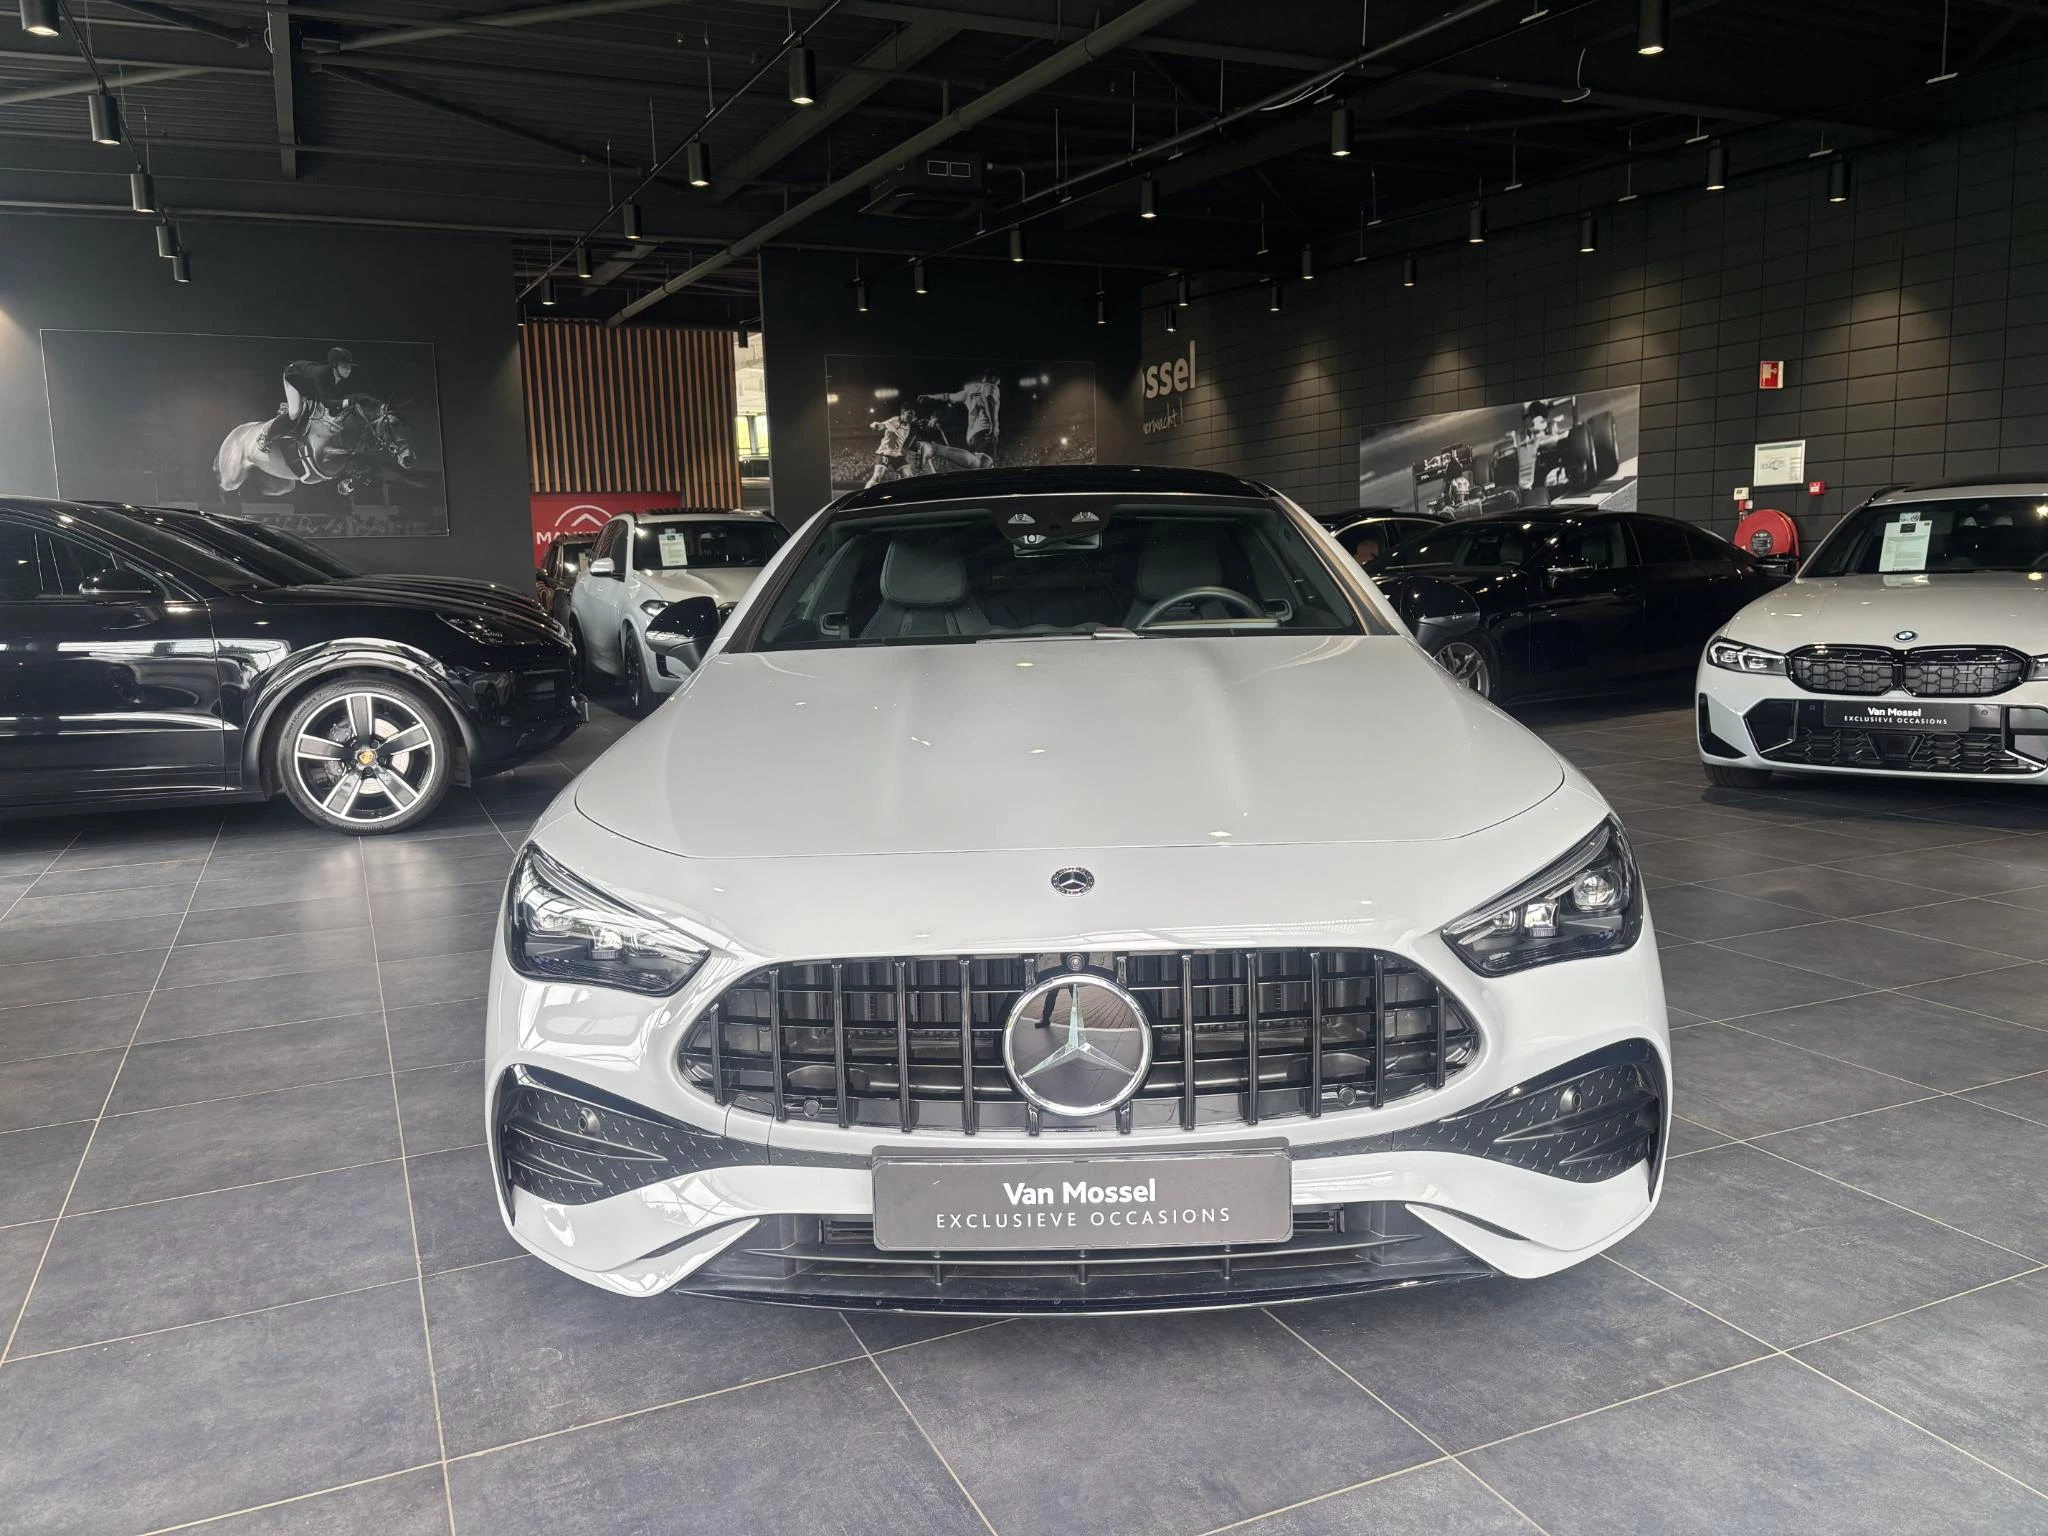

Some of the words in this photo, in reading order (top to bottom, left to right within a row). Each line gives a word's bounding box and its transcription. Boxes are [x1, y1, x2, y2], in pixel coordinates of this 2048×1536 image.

[1142, 339, 1196, 399] ssel
[1844, 715, 1893, 723] EXCLUSIEVE
[1896, 717, 1948, 725] OCCASIONS
[1867, 706, 1886, 716] Van
[1887, 707, 1922, 717] Mossel
[1002, 1182, 1054, 1205] Van
[1063, 1178, 1156, 1204] Mossel
[936, 1212, 1077, 1229] EXCLUSIEVE
[1090, 1207, 1230, 1226] OCCASIONS
